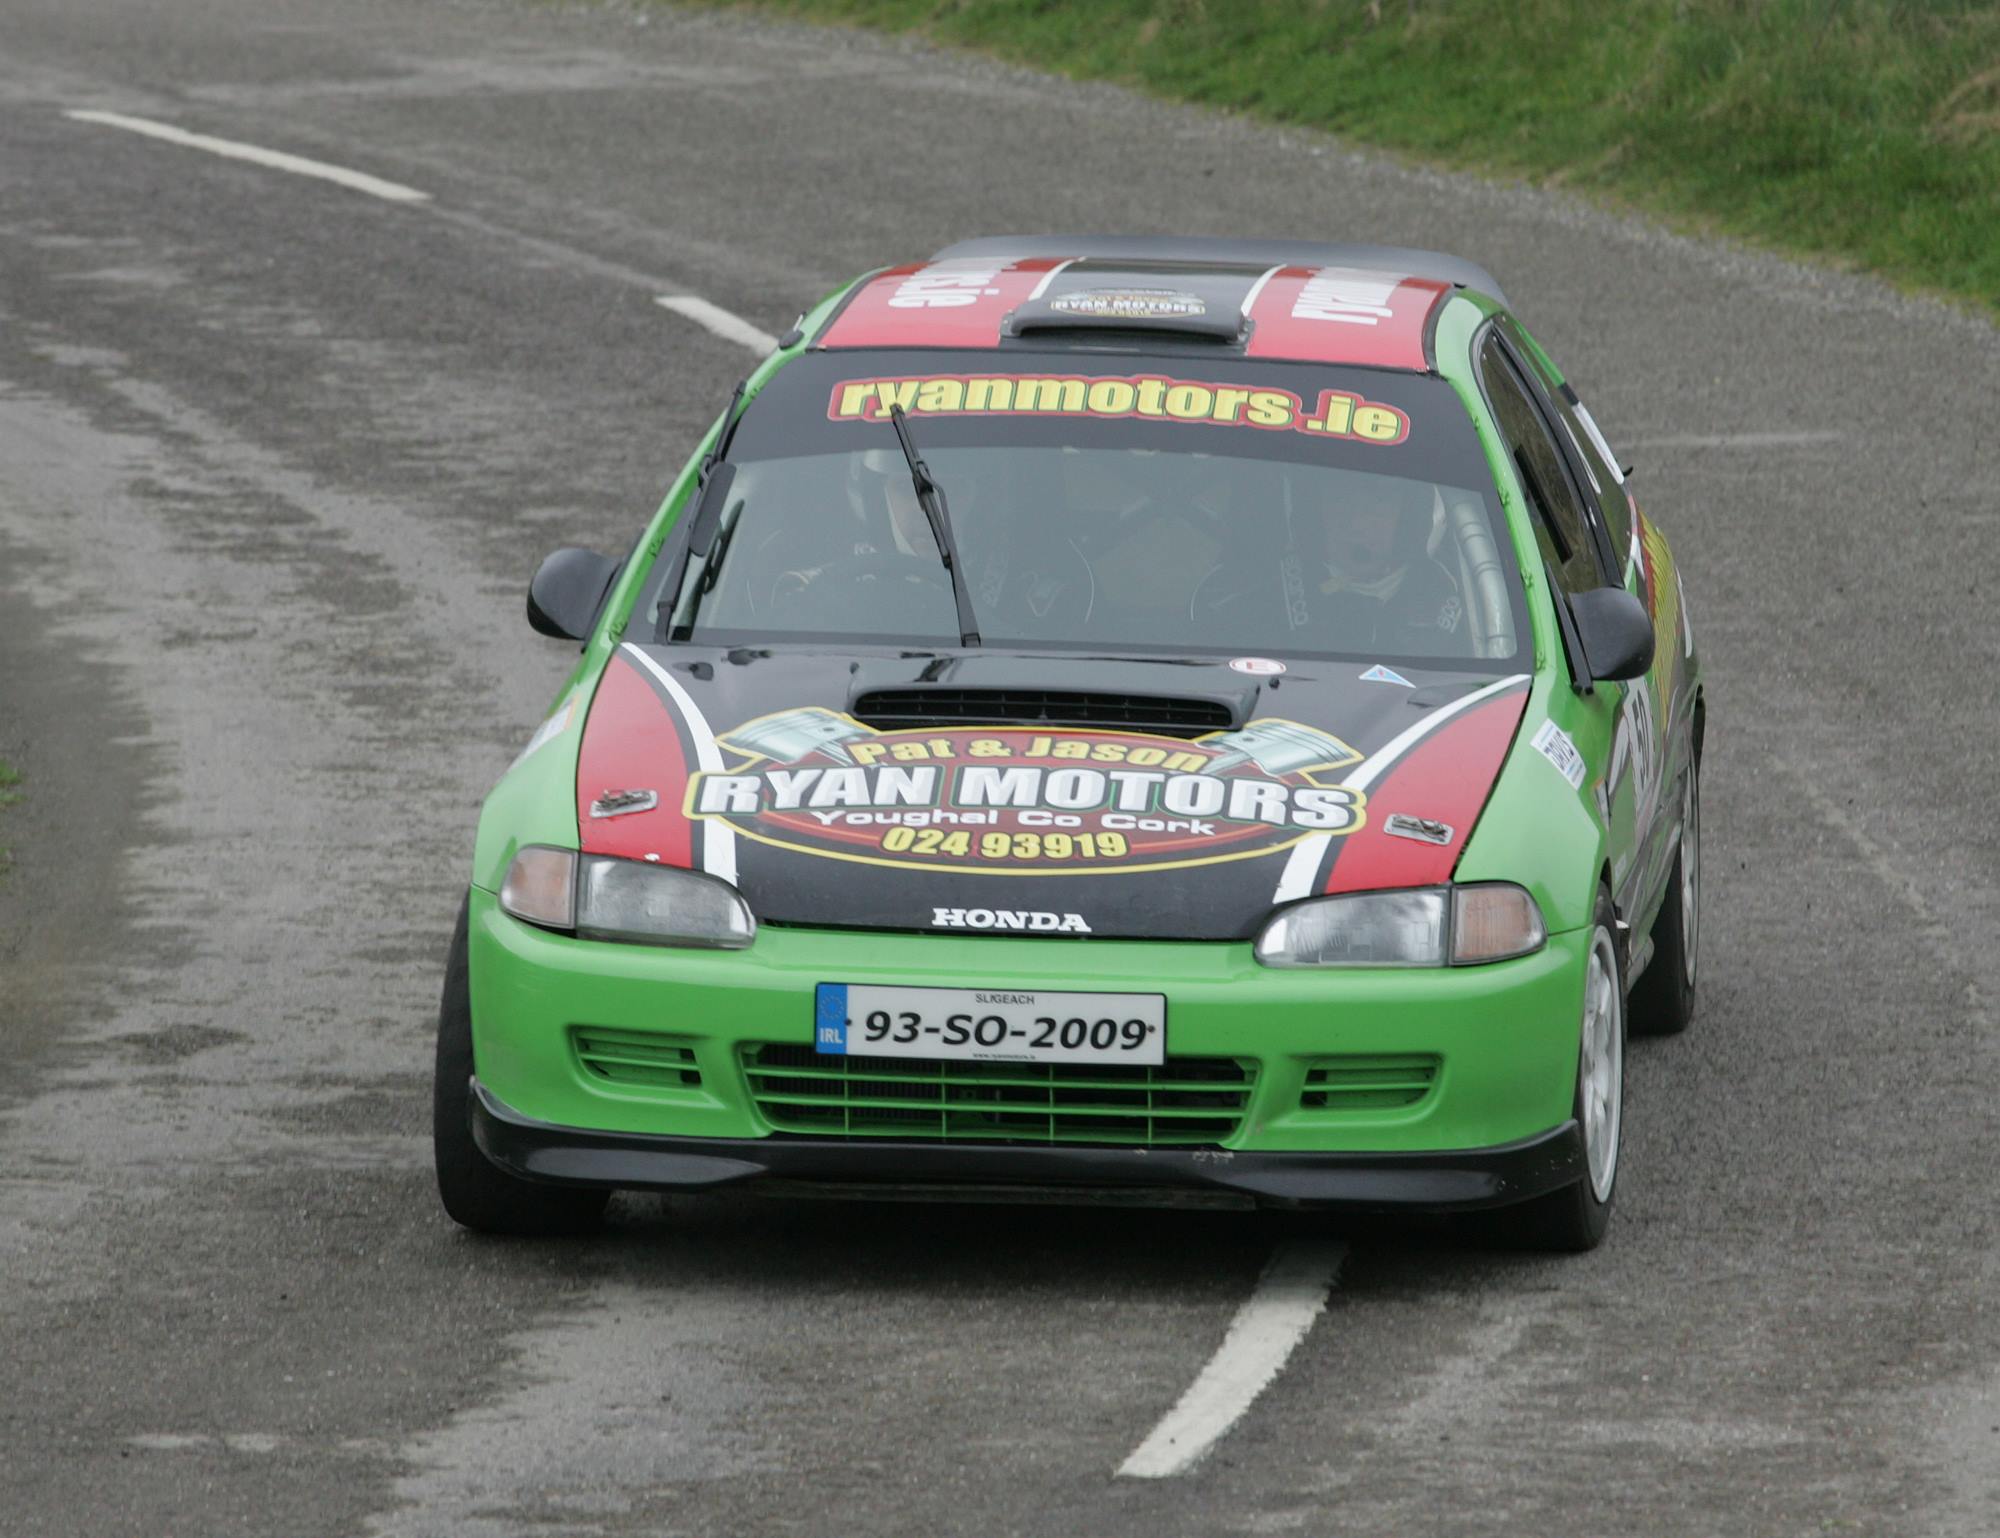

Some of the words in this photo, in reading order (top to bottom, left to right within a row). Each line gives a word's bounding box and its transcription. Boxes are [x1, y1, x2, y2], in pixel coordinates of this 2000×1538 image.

[838, 376, 1402, 441] ryanmotors.ie
[848, 738, 955, 765] Pat
[969, 739, 1011, 758] &
[1025, 738, 1209, 771] Jason
[699, 768, 937, 815] RYAN
[957, 766, 1352, 830] MOTORS
[810, 808, 999, 827] Youghal
[1017, 811, 1082, 828] Co
[1101, 813, 1217, 836] Cork
[882, 826, 970, 856] 024
[981, 829, 1129, 858] 93919
[931, 907, 1091, 932] HONDA
[819, 1028, 844, 1045] IRL
[864, 1011, 1148, 1050] 93-SO-2009
